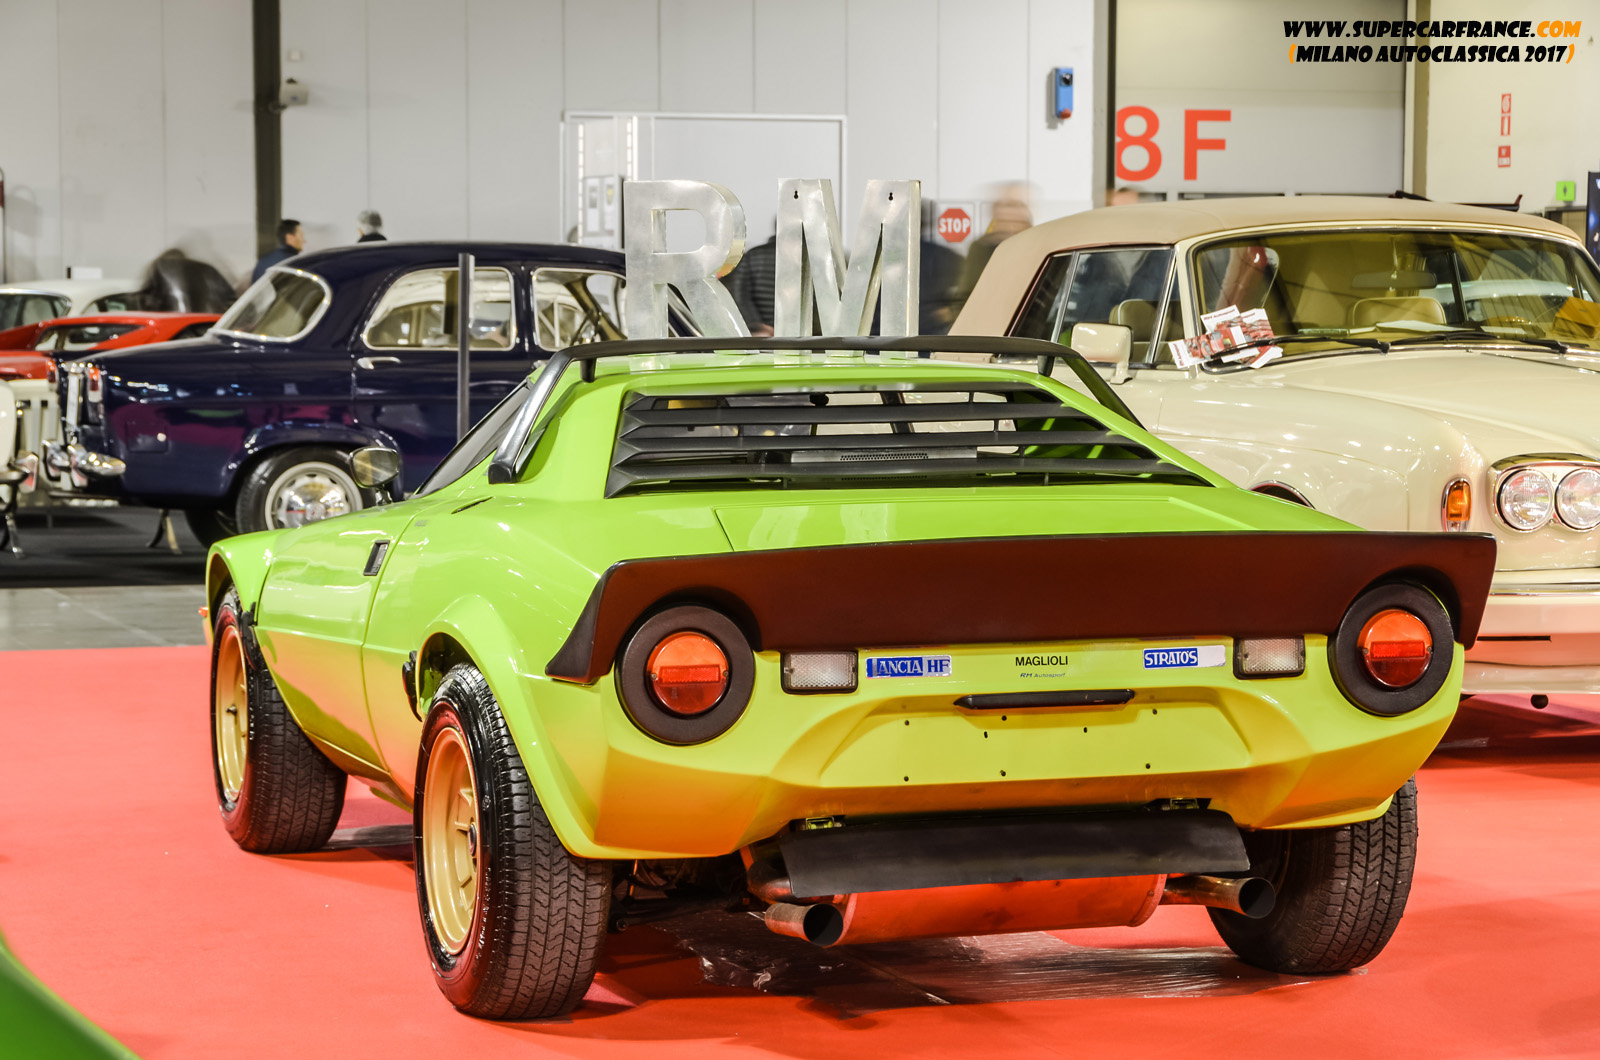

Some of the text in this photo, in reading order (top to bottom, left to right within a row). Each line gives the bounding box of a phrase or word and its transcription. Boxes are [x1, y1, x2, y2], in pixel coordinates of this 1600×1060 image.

[939, 217, 971, 234] STOP
[927, 659, 951, 673] HF
[1015, 655, 1069, 667] MAGLIOLI
